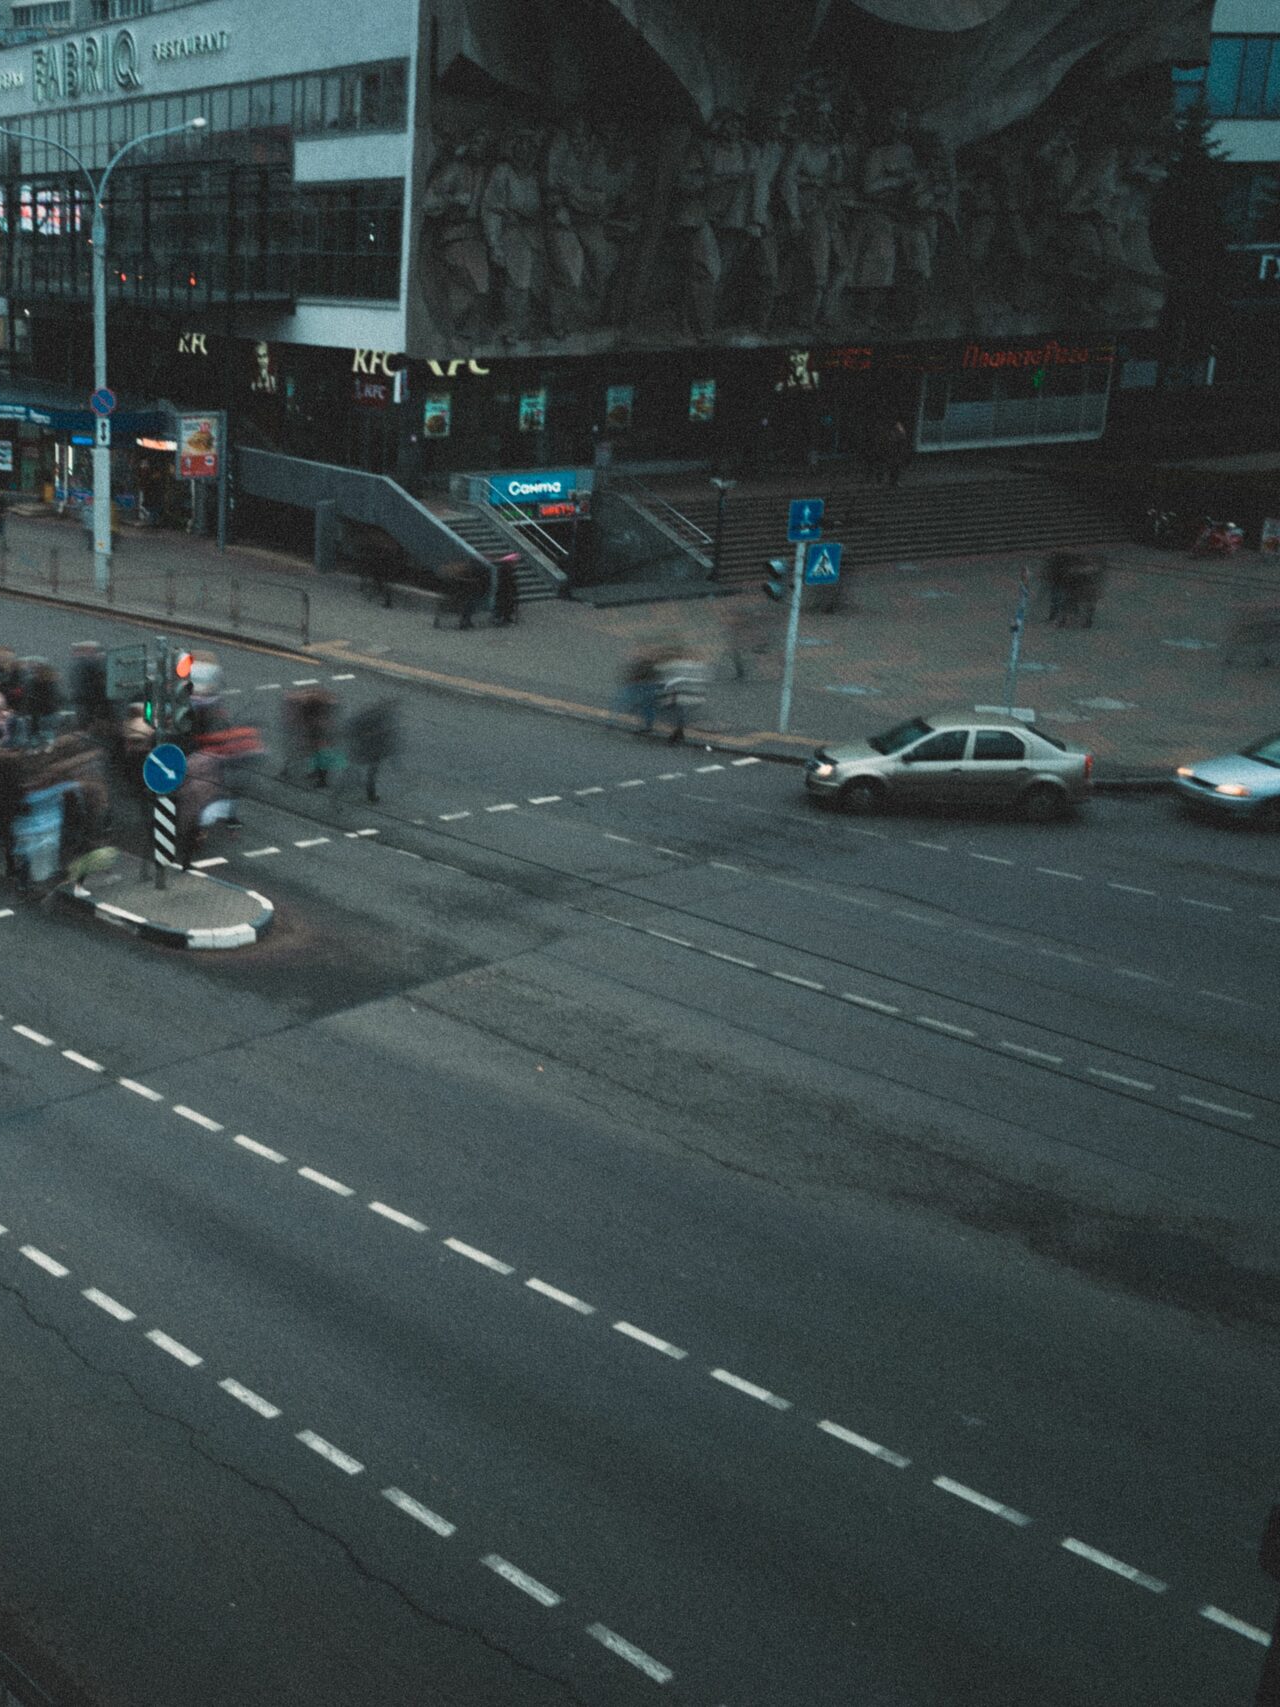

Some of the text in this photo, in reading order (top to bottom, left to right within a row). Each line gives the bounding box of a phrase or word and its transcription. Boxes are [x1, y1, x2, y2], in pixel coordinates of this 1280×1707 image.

[152, 31, 228, 61] RESTAURANT
[32, 28, 141, 104] FABRIQ
[178, 333, 208, 355] KFC
[352, 348, 398, 377] KFC
